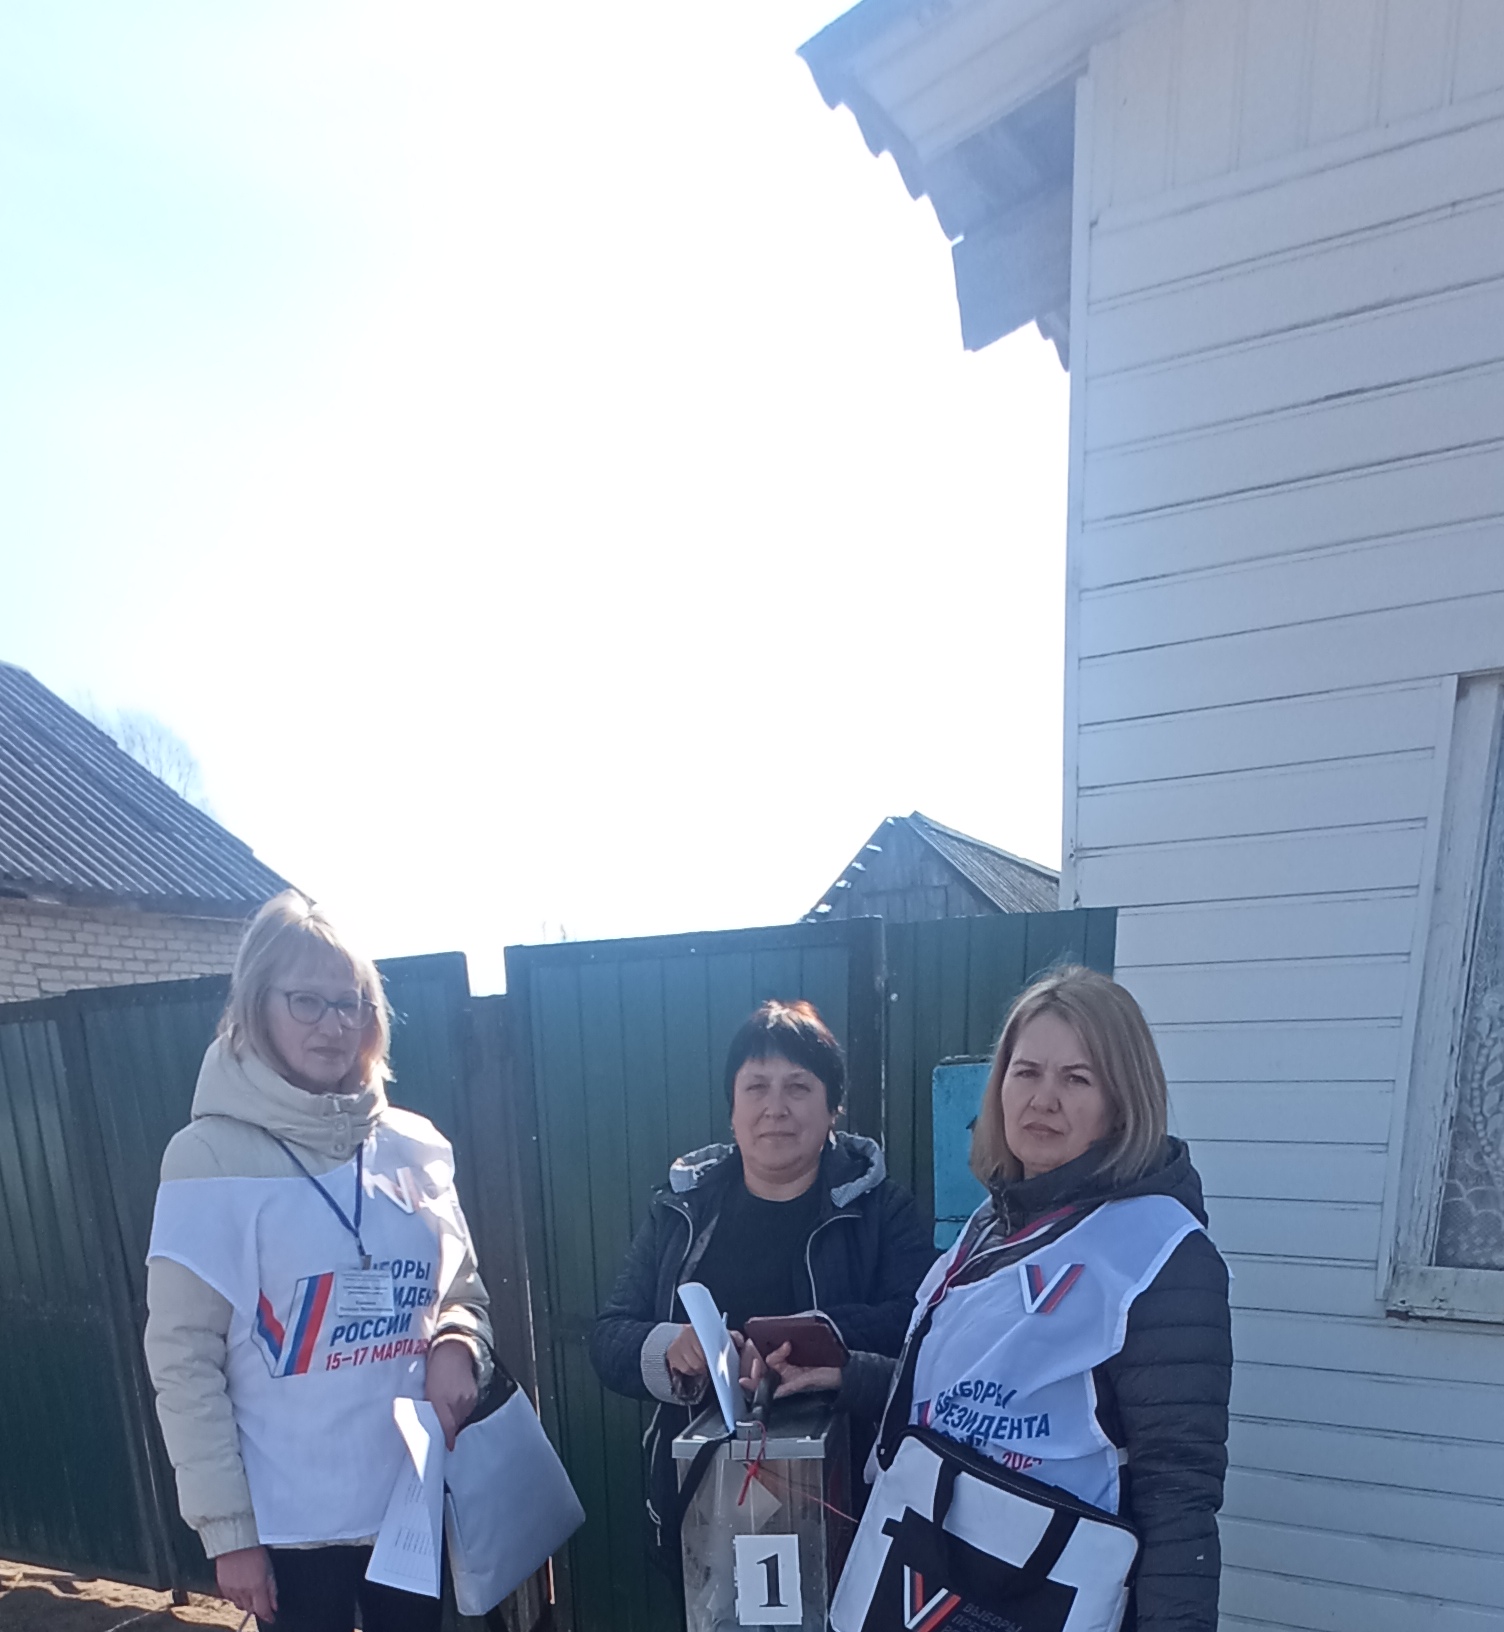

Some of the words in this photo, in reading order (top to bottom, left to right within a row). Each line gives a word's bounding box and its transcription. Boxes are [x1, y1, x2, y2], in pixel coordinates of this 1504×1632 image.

[329, 1313, 412, 1347] РОССИИ
[371, 1339, 413, 1363] МАРТА
[756, 1553, 789, 1608] 1
